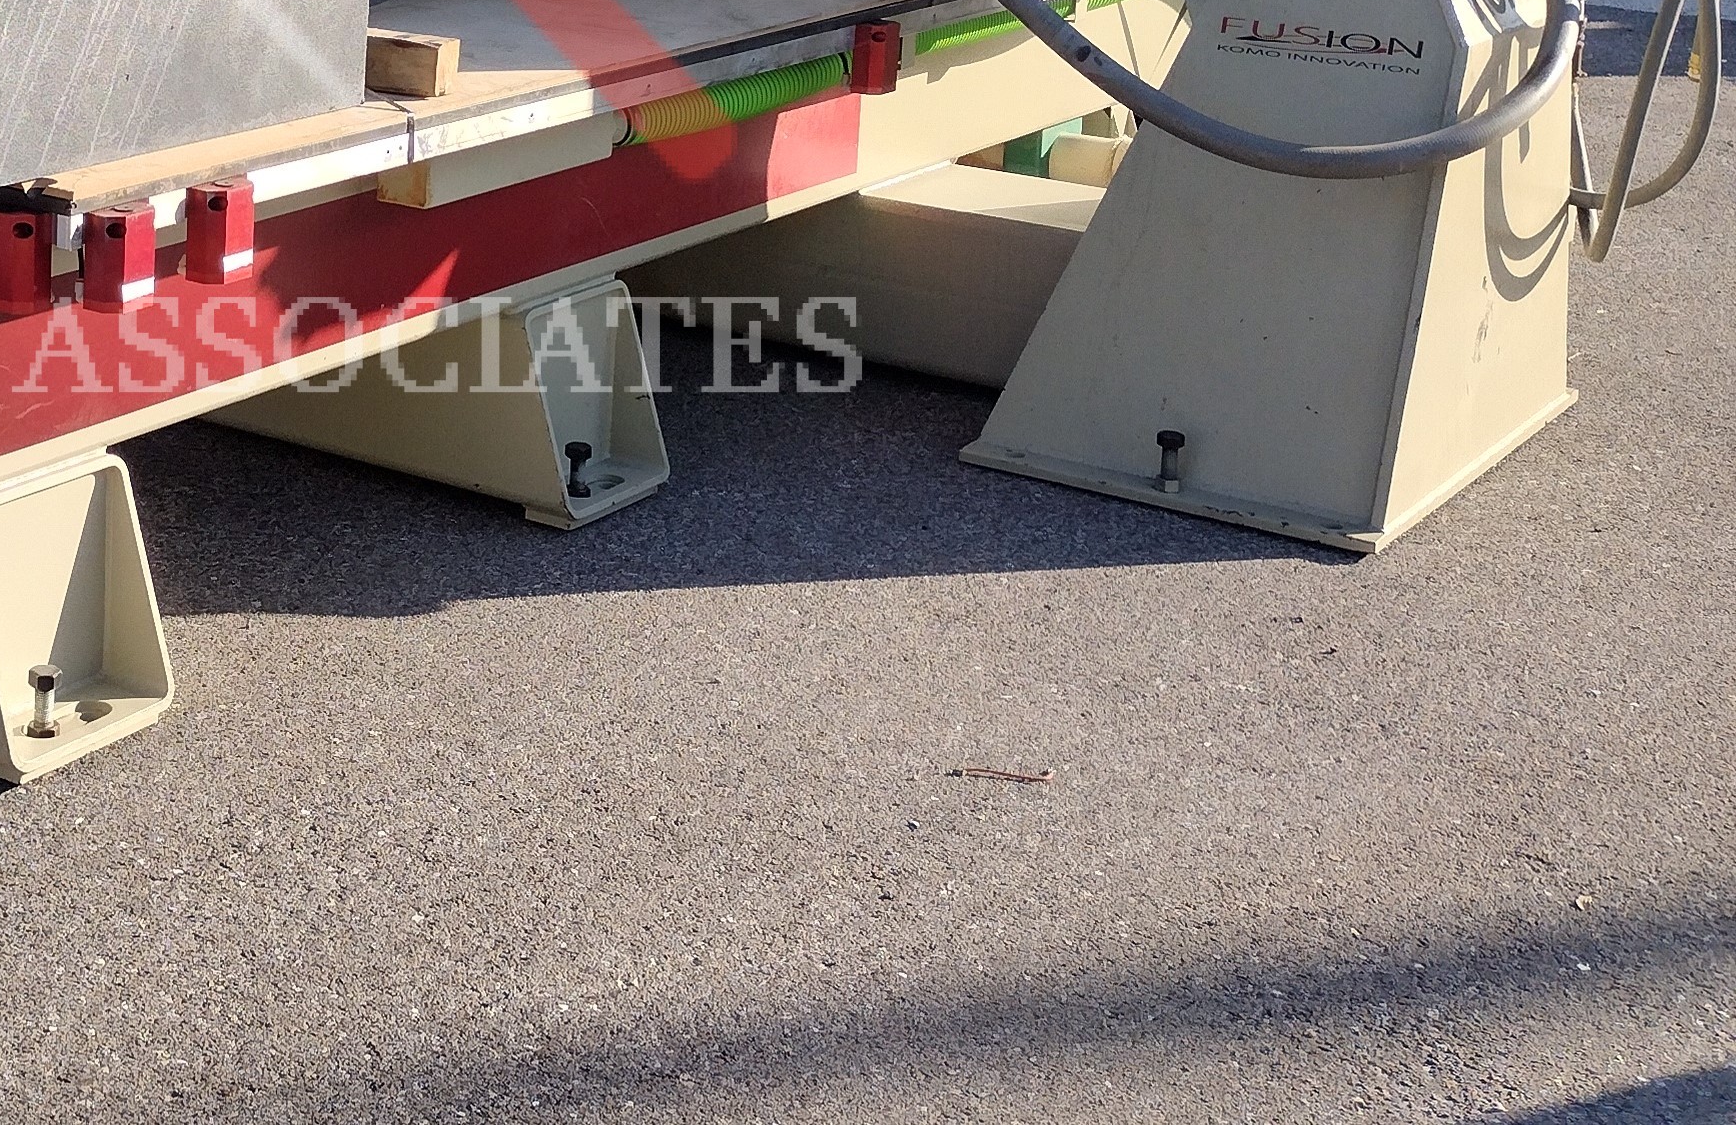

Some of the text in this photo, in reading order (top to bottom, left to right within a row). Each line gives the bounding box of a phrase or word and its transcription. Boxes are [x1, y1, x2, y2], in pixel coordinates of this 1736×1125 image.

[1220, 16, 1424, 59] FUSION
[1217, 43, 1421, 75] KOMO INNOVATION
